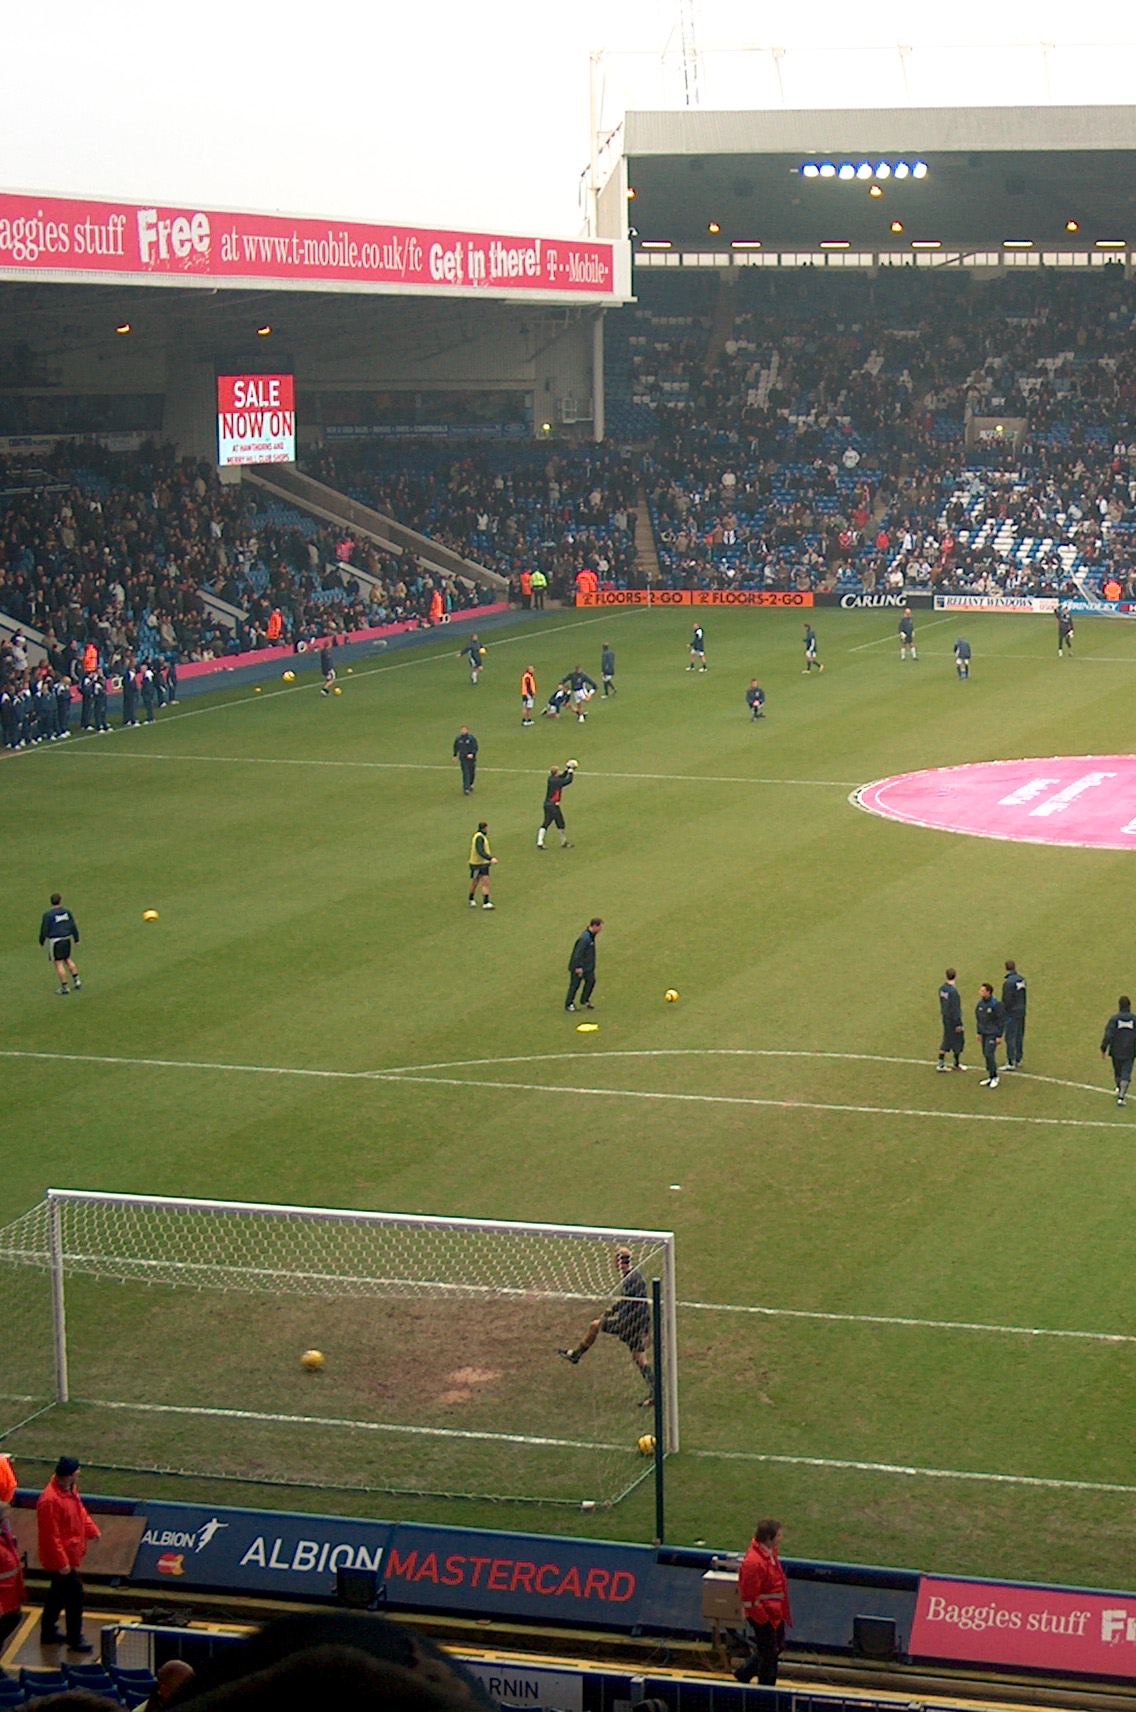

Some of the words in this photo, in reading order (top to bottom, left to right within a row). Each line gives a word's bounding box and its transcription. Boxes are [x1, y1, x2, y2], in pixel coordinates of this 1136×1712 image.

[74, 214, 126, 255] stuff
[137, 208, 211, 263] Free
[221, 226, 239, 262] at
[242, 230, 423, 277] www.t-mobile.co.uk/fc
[430, 242, 463, 281] Get
[468, 241, 486, 281] in
[490, 239, 541, 277] there!
[234, 380, 281, 408] SALE
[223, 411, 265, 439] NOW
[270, 411, 293, 437] ON
[713, 592, 803, 605] FLOORS-2-GO
[841, 594, 908, 608] CARLING
[986, 598, 1033, 607] WINDOWS
[141, 1530, 196, 1548] ALBION
[239, 1537, 383, 1573] ALBION
[384, 1549, 636, 1602] MASTERCARD
[926, 1596, 1022, 1631] Baggies
[1026, 1610, 1091, 1636] stuff
